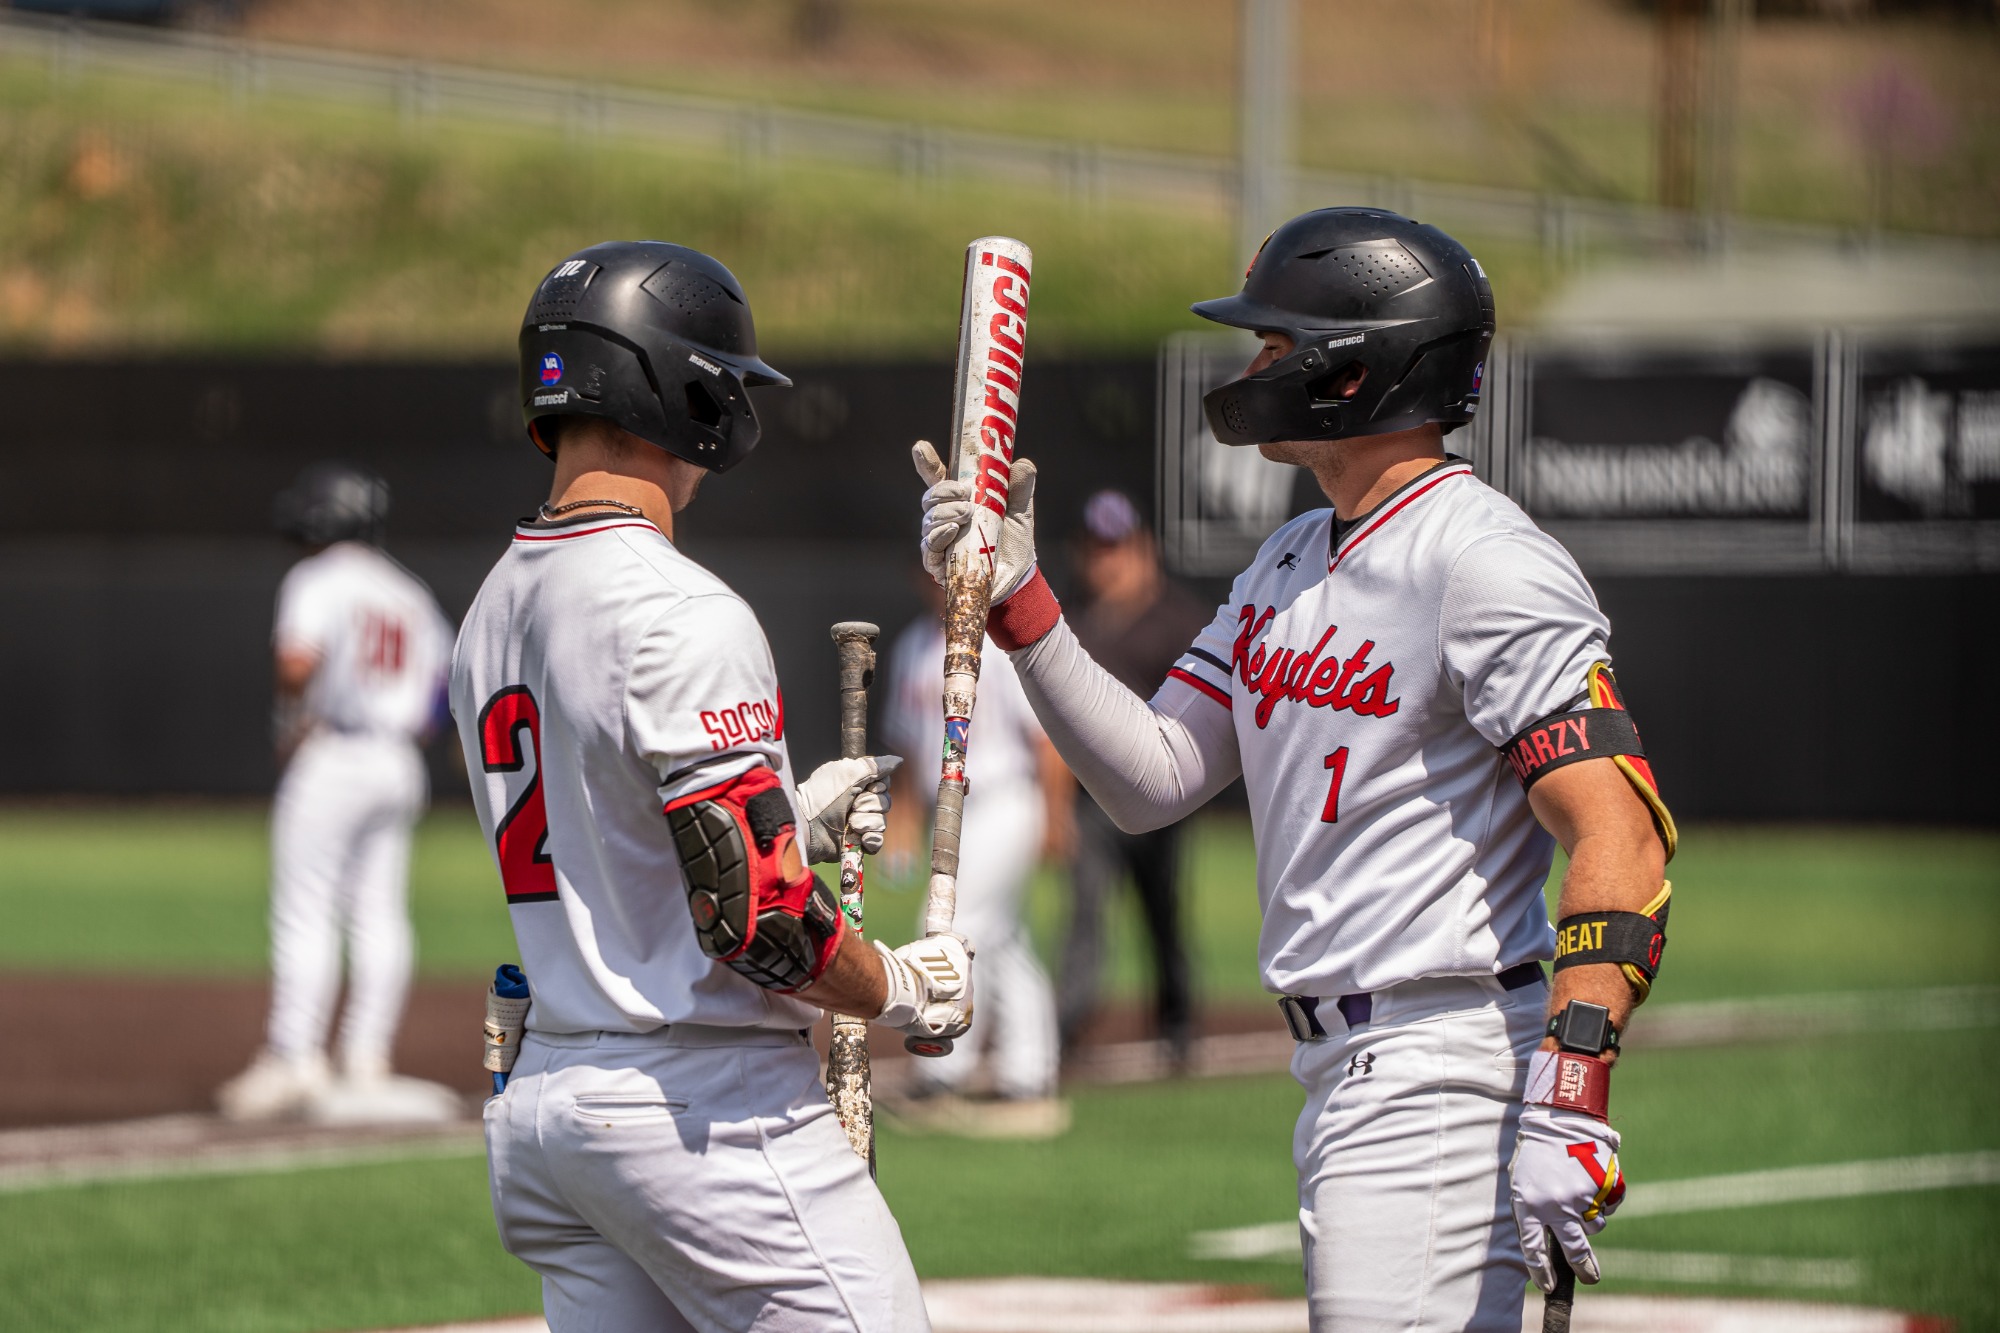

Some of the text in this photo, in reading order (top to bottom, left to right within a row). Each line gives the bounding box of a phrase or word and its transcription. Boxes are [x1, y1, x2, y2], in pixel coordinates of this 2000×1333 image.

[1328, 332, 1365, 349] marucci
[544, 357, 558, 369] VA
[688, 354, 722, 377] marucci
[534, 390, 568, 406] marucci
[974, 251, 1031, 519] marucci
[1232, 603, 1400, 730] Keydets
[478, 684, 560, 904] 2
[1321, 746, 1349, 823] 1
[1577, 1064, 1588, 1096] Southern
